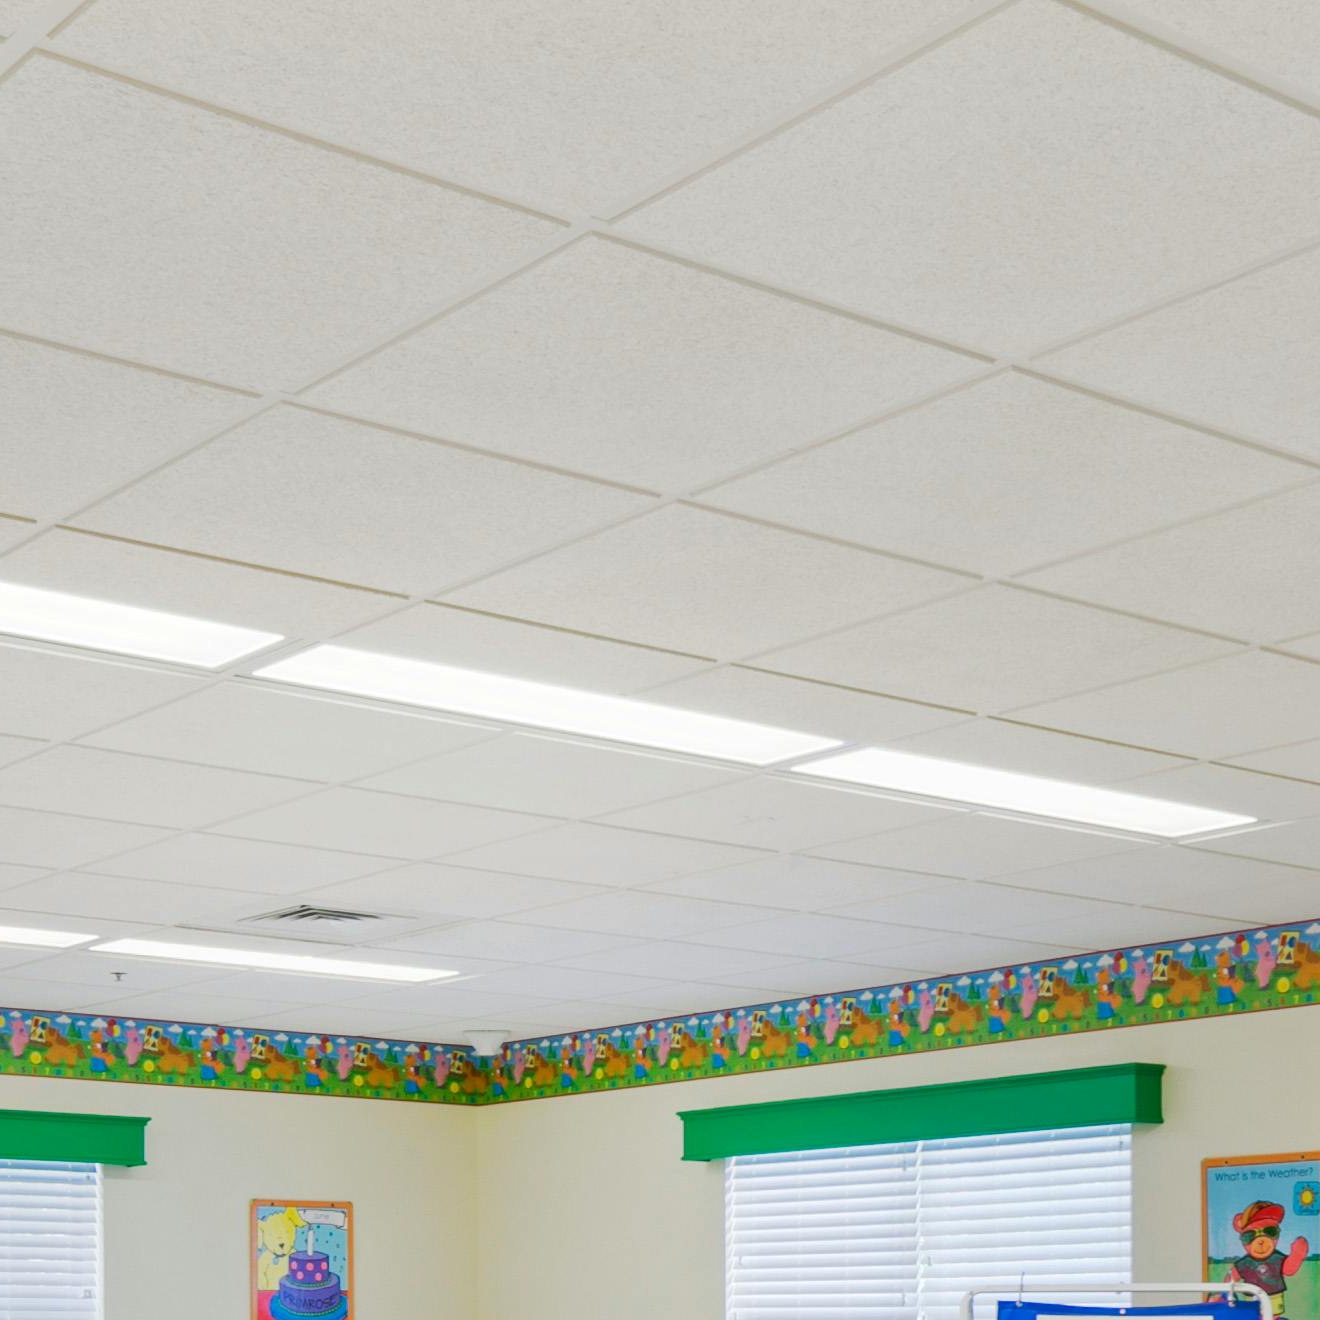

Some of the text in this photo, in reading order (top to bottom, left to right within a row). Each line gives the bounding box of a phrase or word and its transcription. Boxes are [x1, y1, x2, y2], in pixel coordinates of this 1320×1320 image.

[1214, 1172, 1240, 1182] What
[1250, 1170, 1266, 1180] the
[1268, 1166, 1314, 1179] Weather?
